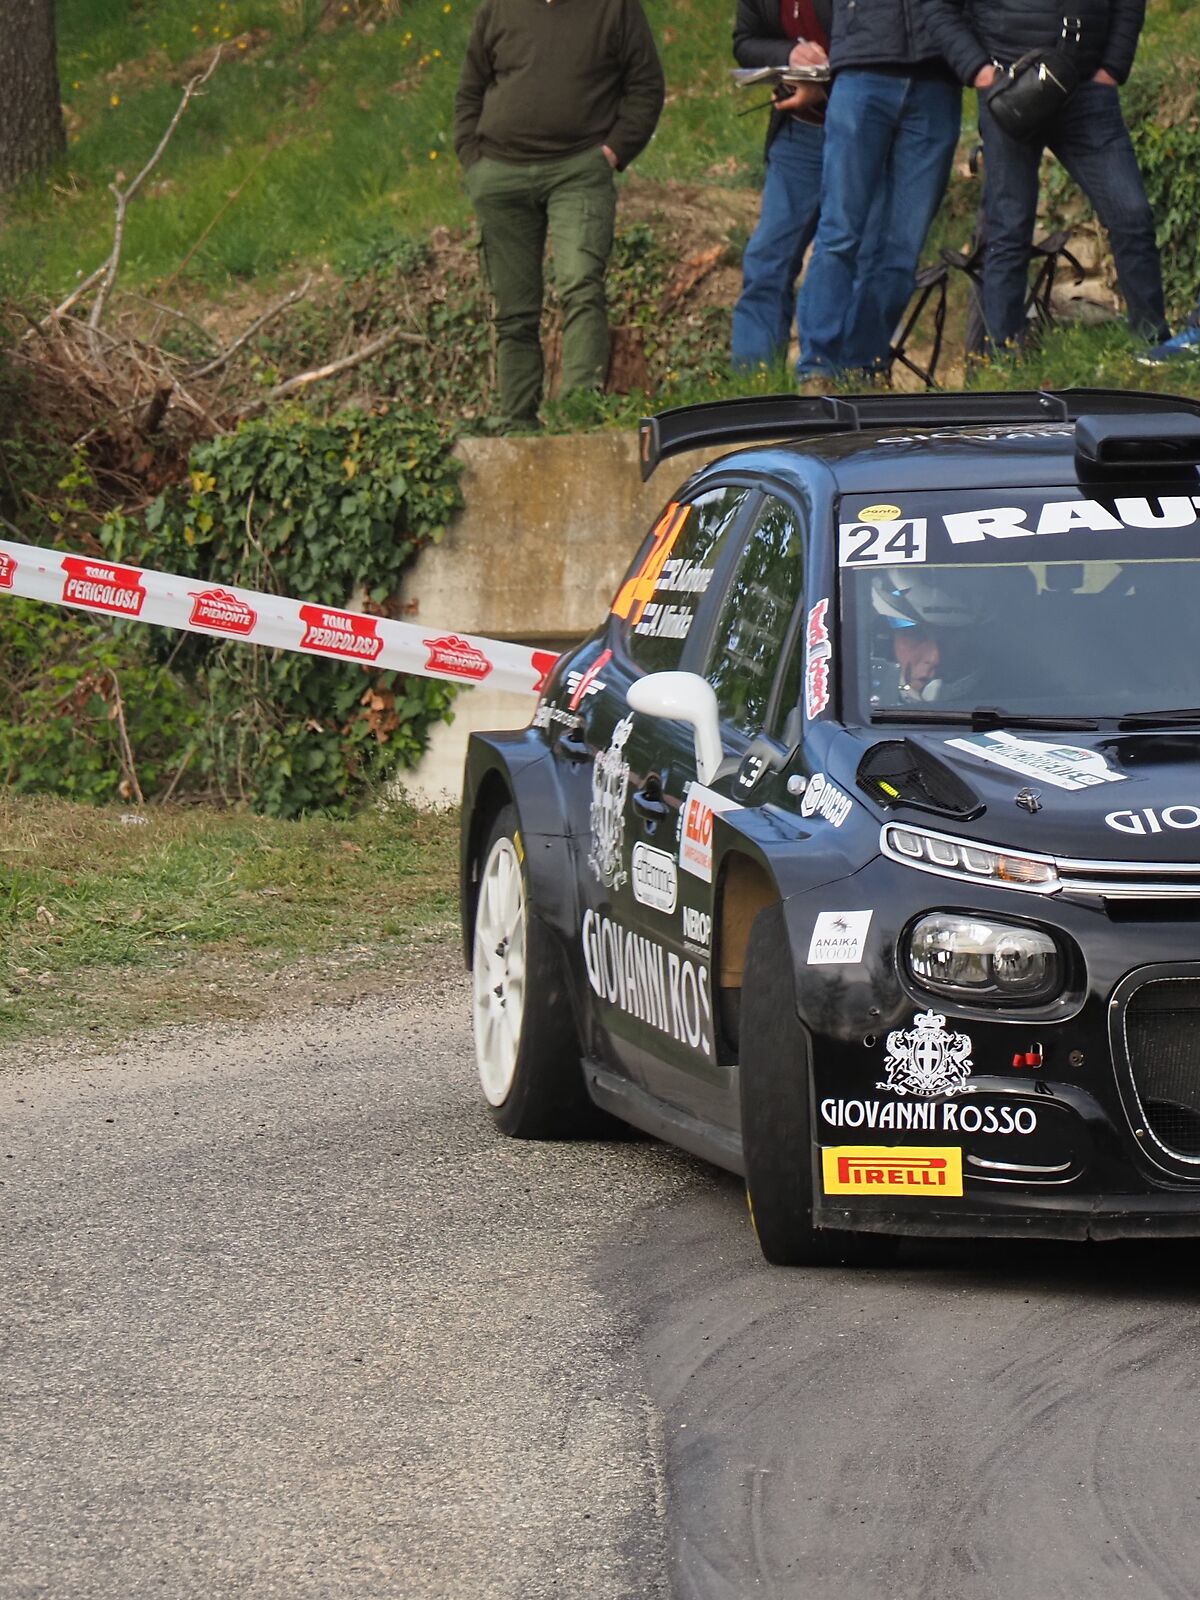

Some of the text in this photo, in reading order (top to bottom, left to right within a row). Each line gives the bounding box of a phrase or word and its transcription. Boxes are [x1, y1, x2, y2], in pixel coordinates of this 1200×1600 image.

[846, 522, 919, 562] 24
[67, 578, 140, 610] PERICOLOSA
[305, 625, 379, 656] PERICOLOSA
[814, 947, 858, 960] WOOD
[815, 938, 858, 947] ANAIKA
[582, 908, 670, 1033] GIOVANNI
[820, 1099, 1037, 1135] GIOVANNI ROSSO
[837, 1156, 948, 1186] PIRELLI
